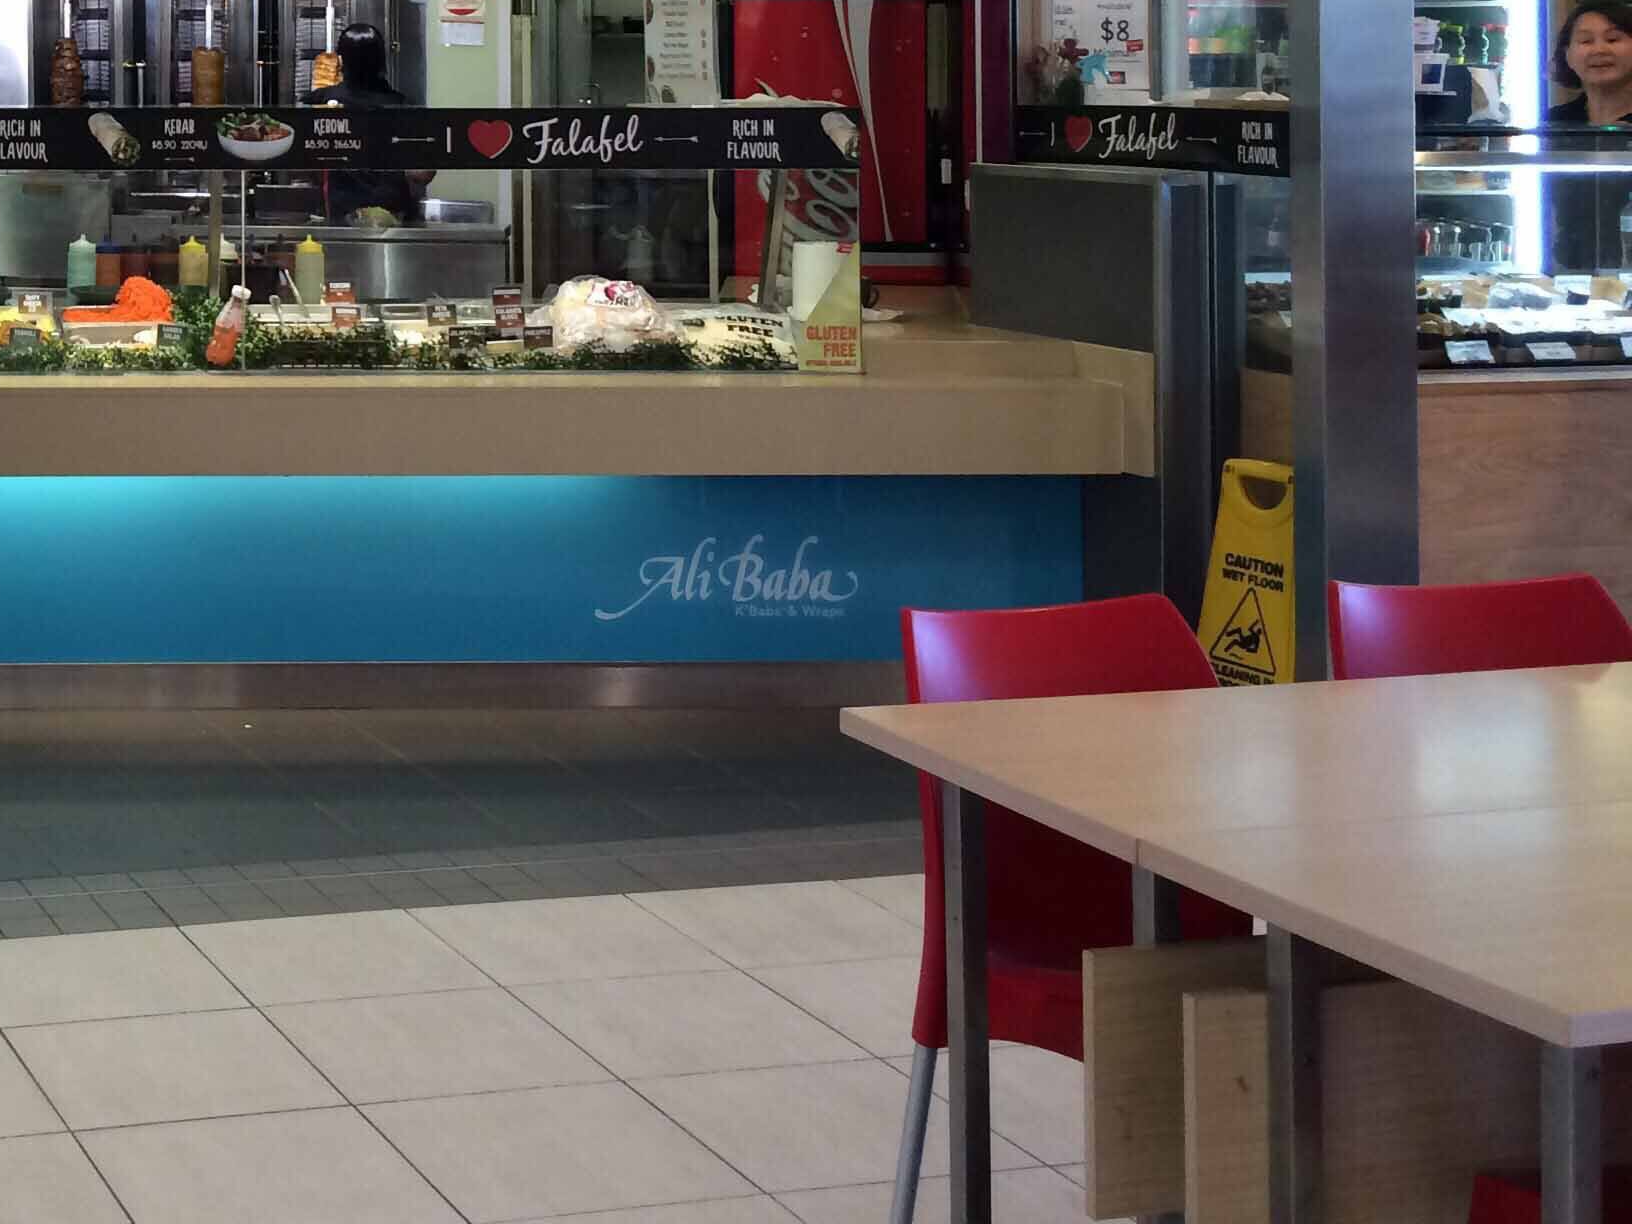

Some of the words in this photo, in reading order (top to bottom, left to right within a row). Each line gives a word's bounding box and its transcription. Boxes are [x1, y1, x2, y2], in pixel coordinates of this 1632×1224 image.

[1100, 17, 1130, 44] $8
[0, 119, 24, 140] RICH
[30, 119, 41, 137] IN
[164, 119, 195, 137] KEBAB
[313, 118, 351, 137] KEBOWL
[733, 119, 759, 138] RICH
[763, 119, 774, 136] IN
[1098, 112, 1179, 160] Falafel
[1241, 121, 1261, 142] RICH
[1264, 122, 1273, 140] IN
[446, 127, 452, 153] I
[523, 114, 644, 164] Falafel
[728, 141, 781, 162] FLAVOUR
[1237, 144, 1279, 169] FLAVOUR
[717, 315, 784, 328] LUTEN
[727, 325, 774, 338] FREE
[806, 326, 856, 340] GLUTEN
[823, 342, 856, 357] FREE
[1225, 553, 1284, 578] CAUTION
[594, 536, 717, 620] Ali
[719, 534, 859, 602] Baba
[1222, 568, 1245, 582] WET
[1248, 575, 1284, 592] FLOOR
[1211, 661, 1261, 685] LEANING
